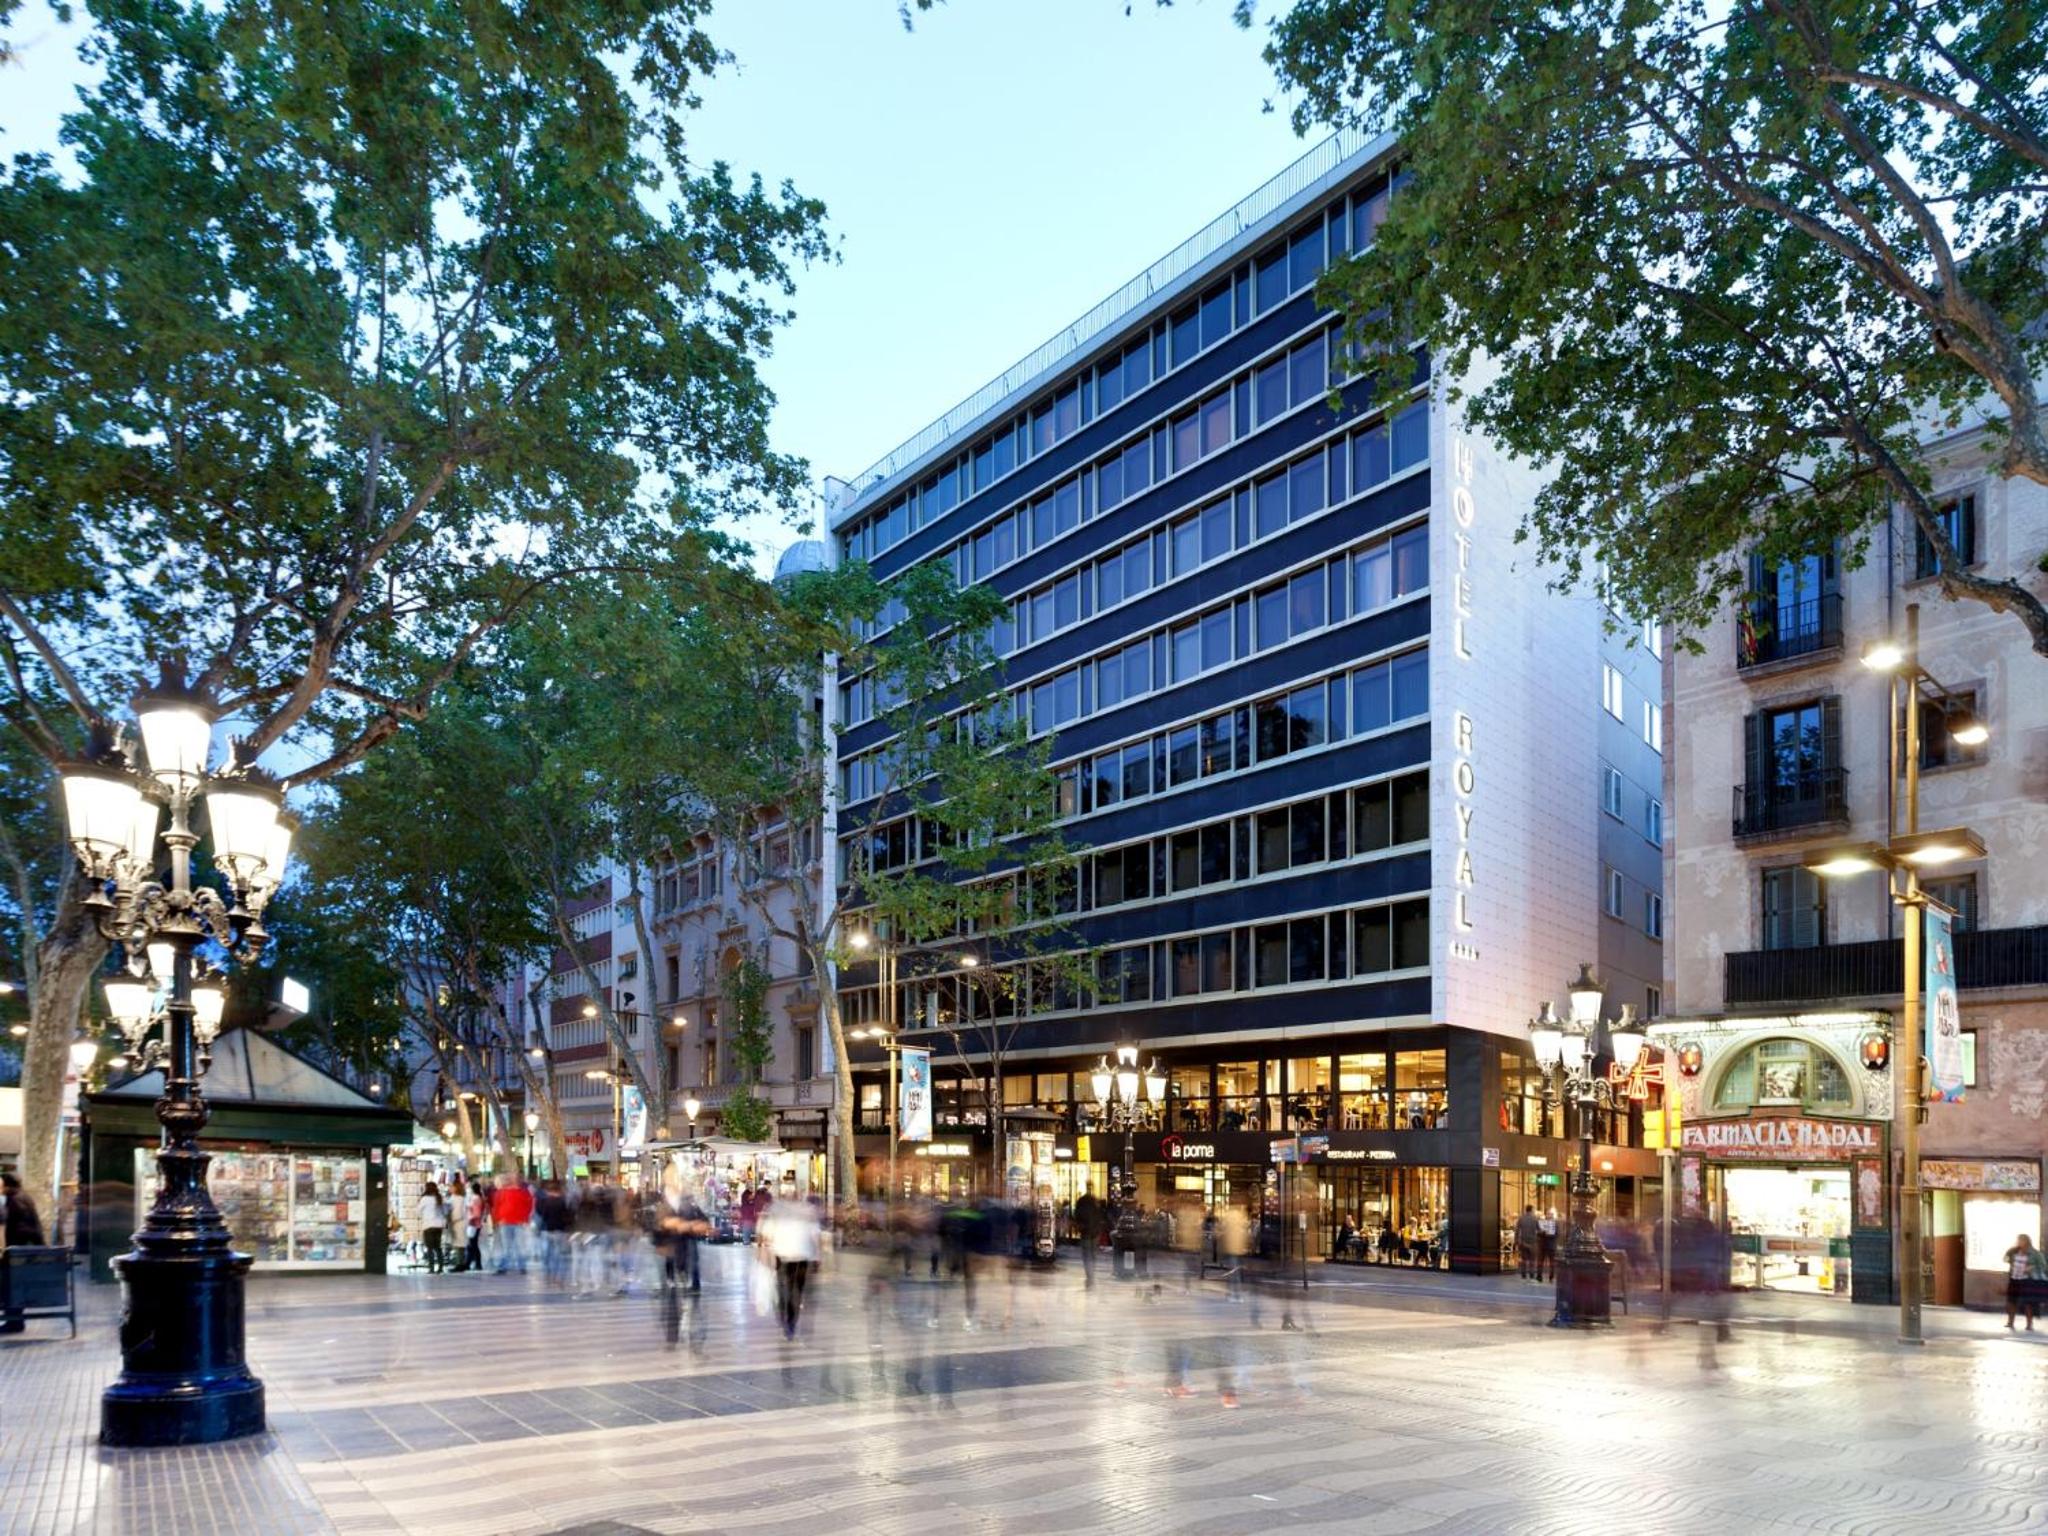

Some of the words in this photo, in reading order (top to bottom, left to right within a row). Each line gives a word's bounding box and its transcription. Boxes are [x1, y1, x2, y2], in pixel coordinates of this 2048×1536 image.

[1453, 438, 1474, 662] HOTEL
[1453, 710, 1474, 933] ROYAL
[1172, 1142, 1182, 1158] la
[1183, 1144, 1215, 1160] poma
[1683, 1121, 1793, 1147] FARMACIA
[1797, 1122, 1878, 1147] NADAL
